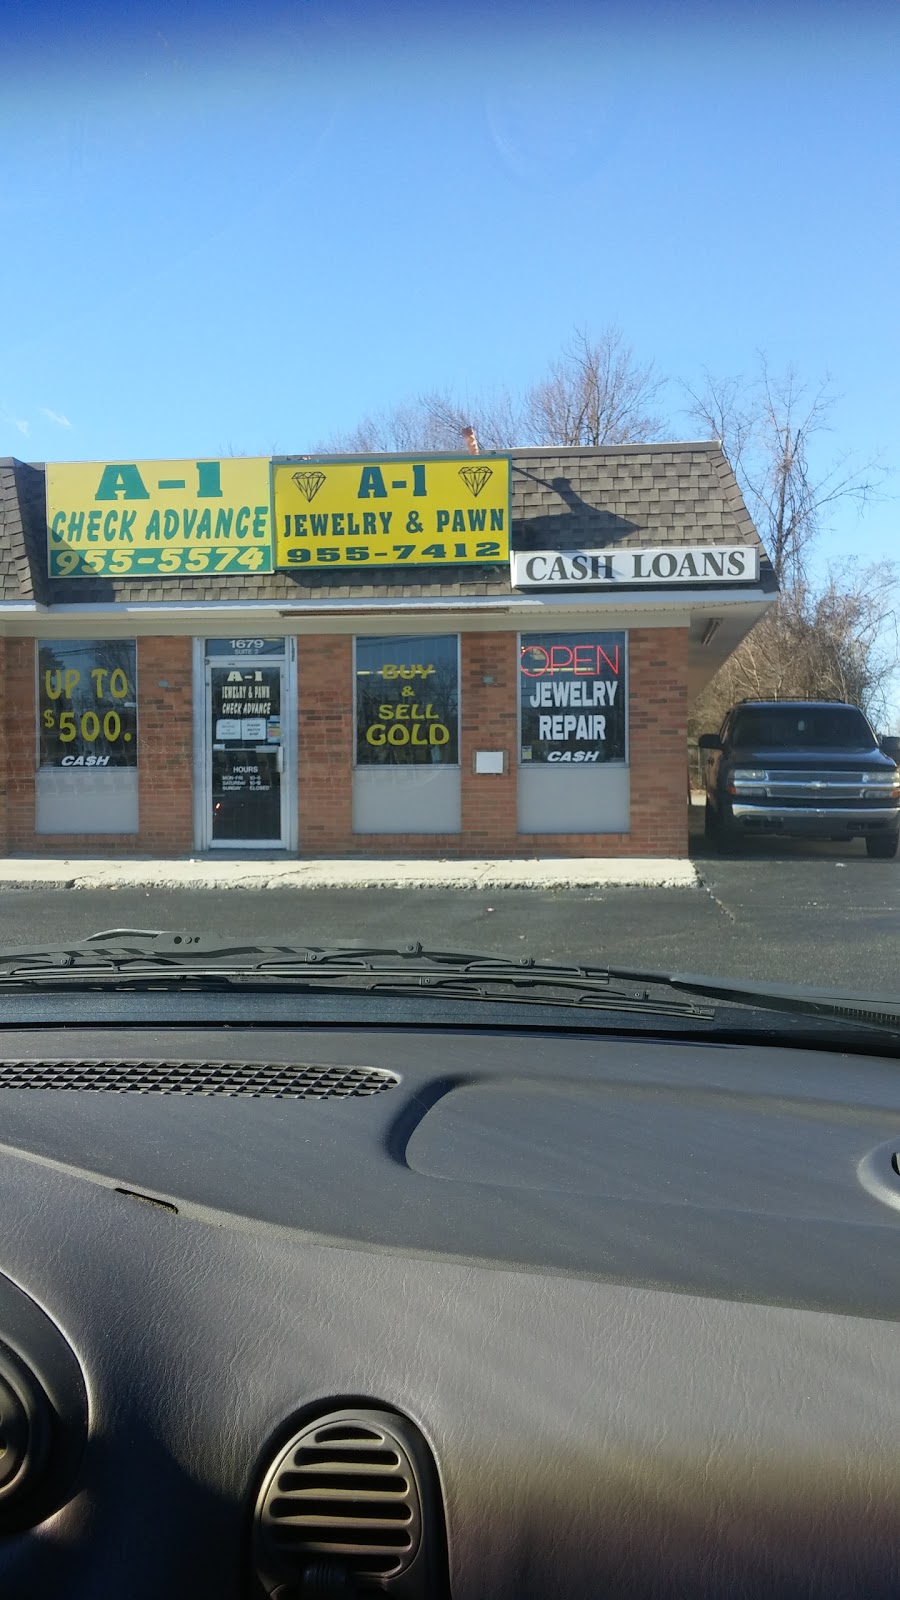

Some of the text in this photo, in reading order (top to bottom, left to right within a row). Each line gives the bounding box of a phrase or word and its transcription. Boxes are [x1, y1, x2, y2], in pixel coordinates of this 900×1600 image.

[94, 461, 223, 501] A-1
[357, 464, 427, 498] A-1
[51, 506, 269, 543] CHECK ADVANCE
[283, 508, 504, 538] JEWELRY & PAWN
[55, 546, 264, 576] 955-5574
[286, 541, 501, 563] 955-7412
[525, 551, 746, 582] CASH LOANS
[228, 639, 265, 649] 1679
[382, 664, 434, 679] BUY
[519, 644, 620, 677] OPEN
[45, 668, 128, 700] UP TO
[221, 686, 246, 699] JEWELRY
[254, 686, 270, 699] PAWN
[401, 685, 416, 697] &
[529, 681, 619, 708] JEWELRY
[222, 702, 271, 715] CHECK ADVANCE
[378, 703, 440, 720] SELL
[366, 723, 450, 746] GOLD
[539, 714, 607, 741] REPAIR
